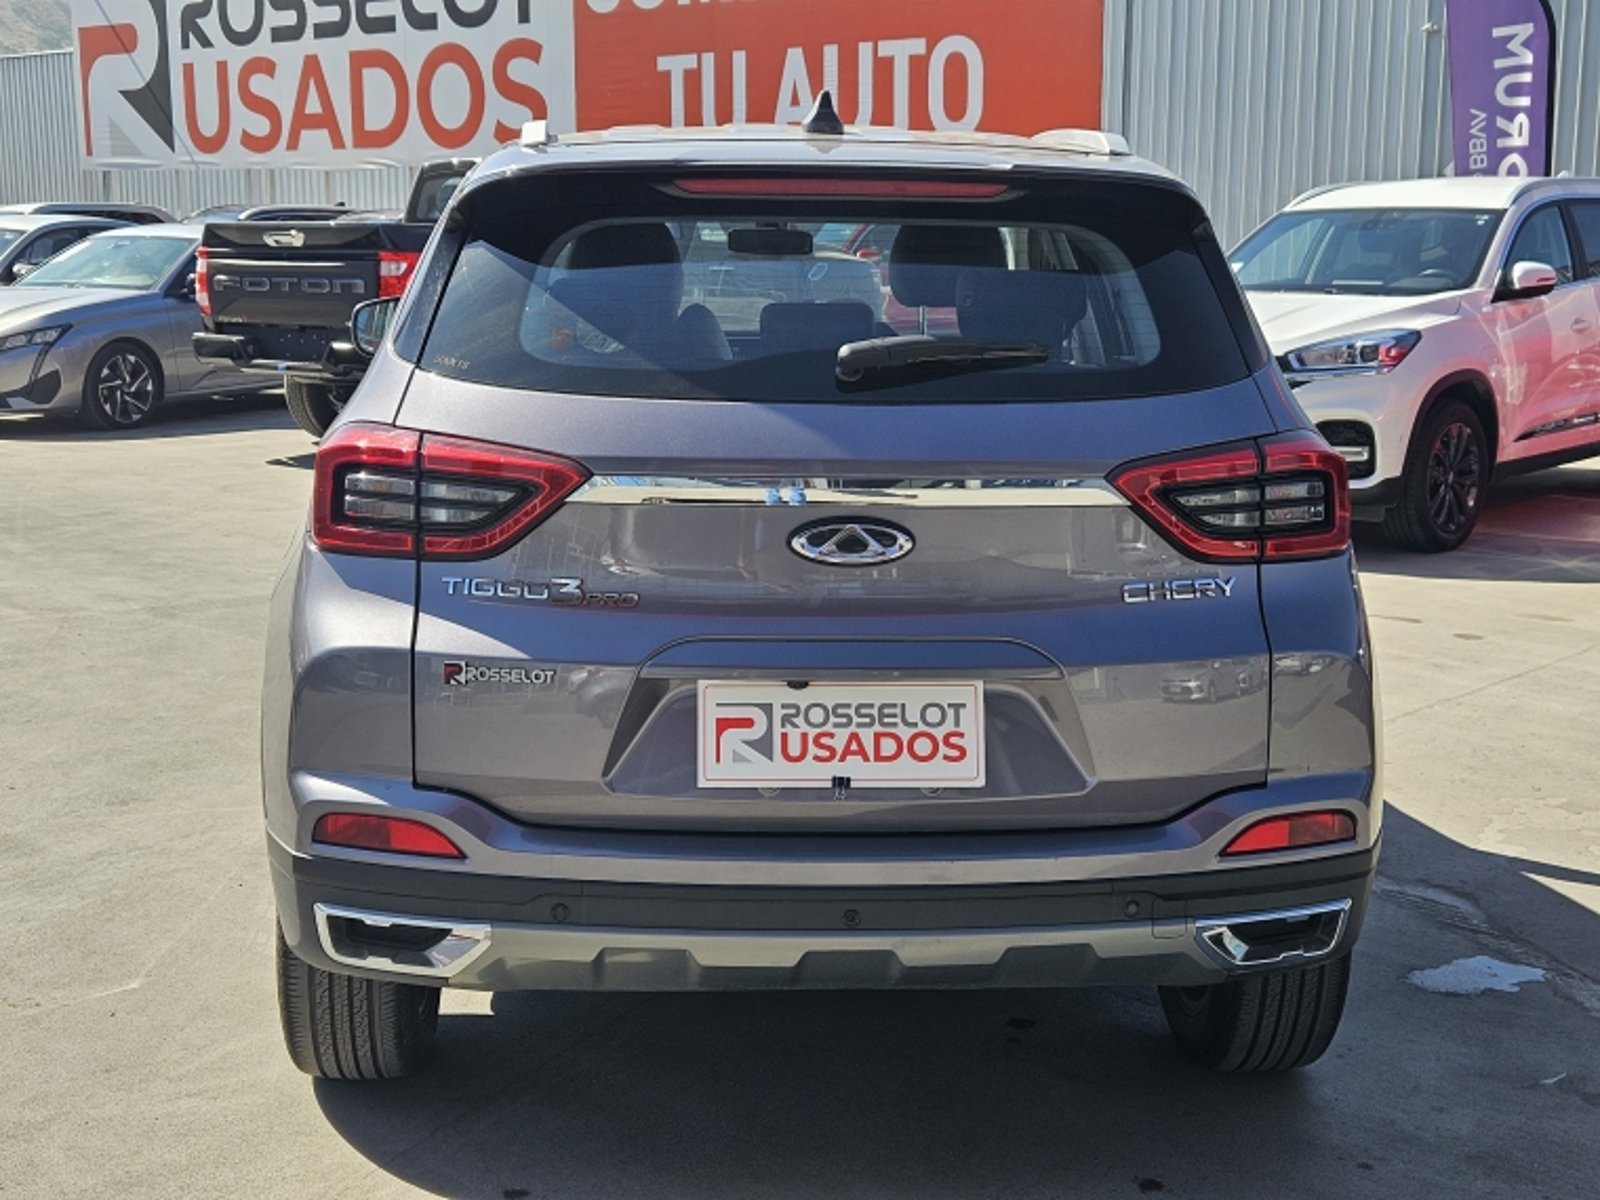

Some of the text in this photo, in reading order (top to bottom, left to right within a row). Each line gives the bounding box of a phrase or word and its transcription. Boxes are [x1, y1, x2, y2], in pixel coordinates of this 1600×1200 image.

[181, 37, 548, 154] USADOS
[773, 34, 985, 132] AUTO
[212, 274, 365, 294] FOTON
[1121, 576, 1236, 603] CHERY
[466, 665, 555, 684] ROSSELOT
[780, 702, 967, 729] ROSSELOT
[780, 730, 967, 764] USADOS
